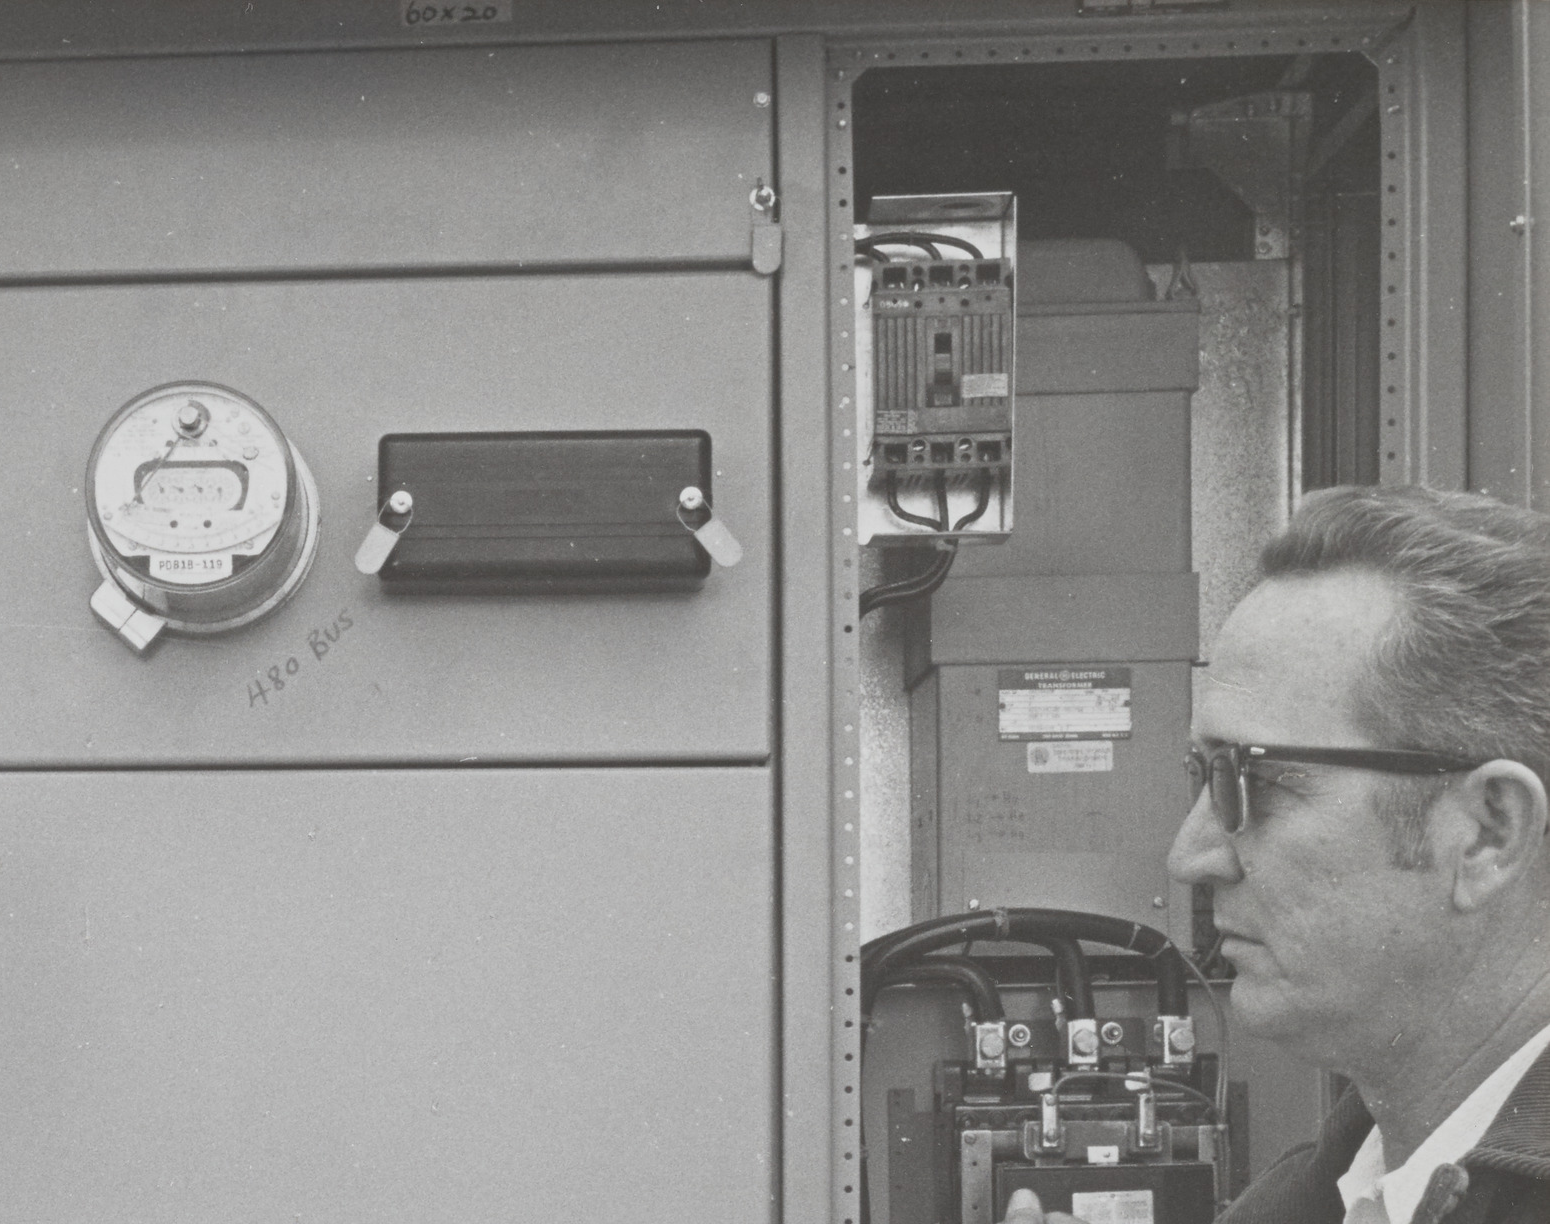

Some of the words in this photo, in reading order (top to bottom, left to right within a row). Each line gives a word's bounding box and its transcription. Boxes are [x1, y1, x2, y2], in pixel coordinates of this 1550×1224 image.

[247, 665, 300, 707] 480
[1024, 672, 1059, 680] GENERAL
[1071, 671, 1106, 679] ELECTRIC
